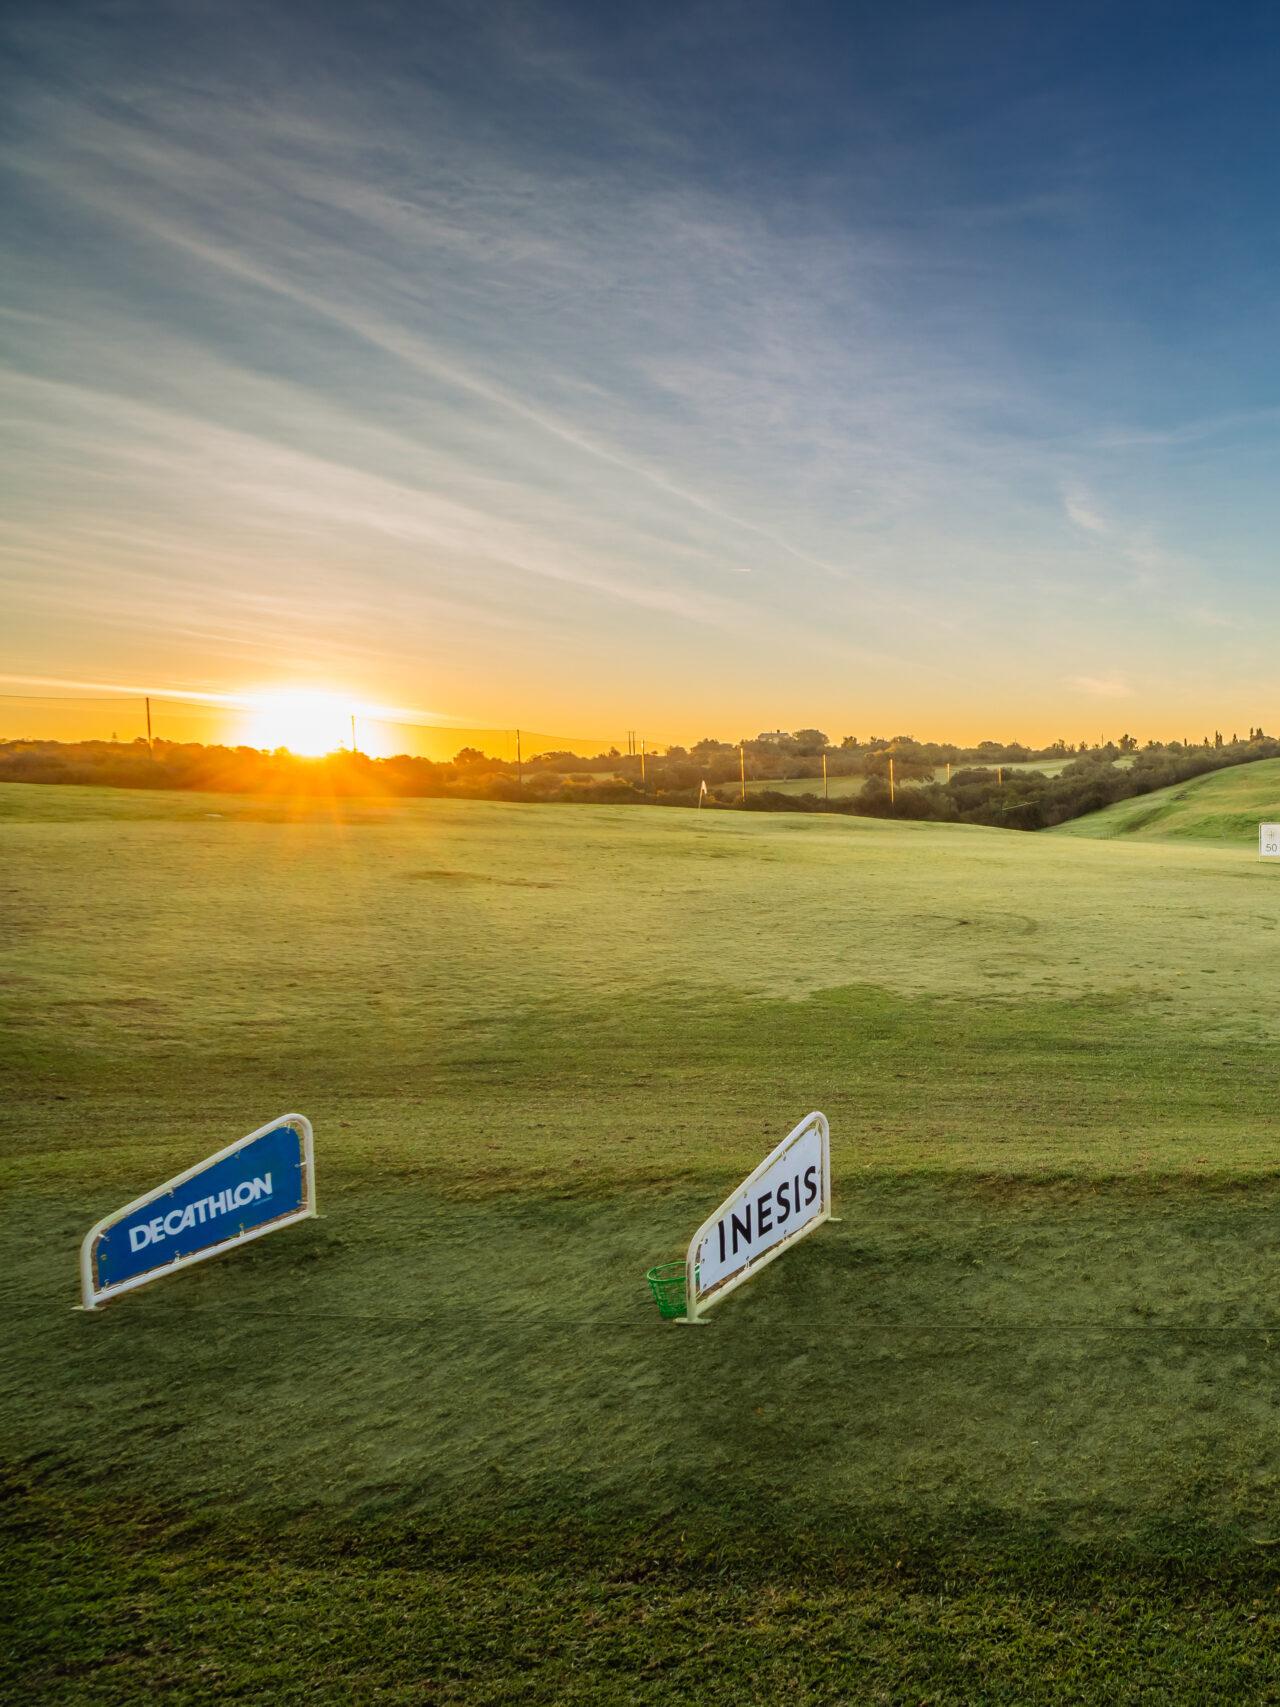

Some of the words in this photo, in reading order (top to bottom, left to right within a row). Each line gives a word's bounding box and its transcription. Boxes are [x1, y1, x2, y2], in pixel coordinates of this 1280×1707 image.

[1265, 843, 1278, 852] 50
[128, 1172, 273, 1253] DECATHLON
[717, 1165, 818, 1263] INESIS
